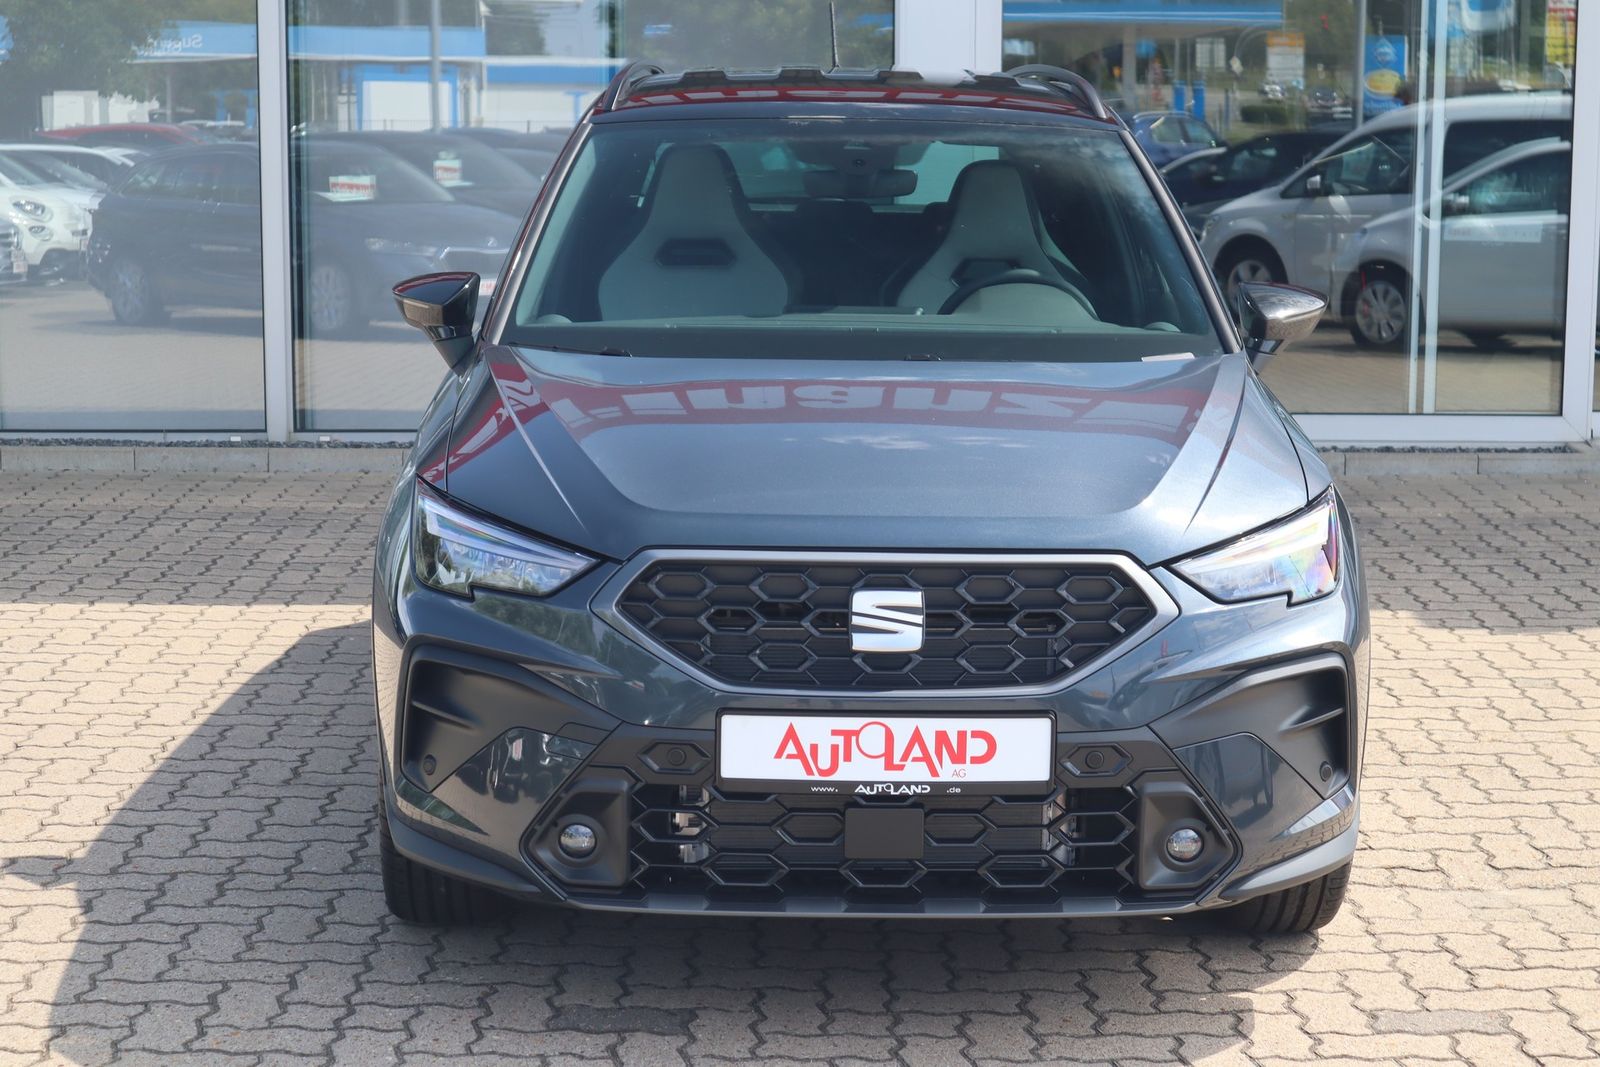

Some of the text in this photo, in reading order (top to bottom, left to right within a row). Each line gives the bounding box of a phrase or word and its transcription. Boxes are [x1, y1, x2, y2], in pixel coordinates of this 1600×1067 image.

[773, 721, 998, 777] AUTOLAND
[951, 768, 967, 778] AG
[946, 786, 961, 794] .de
